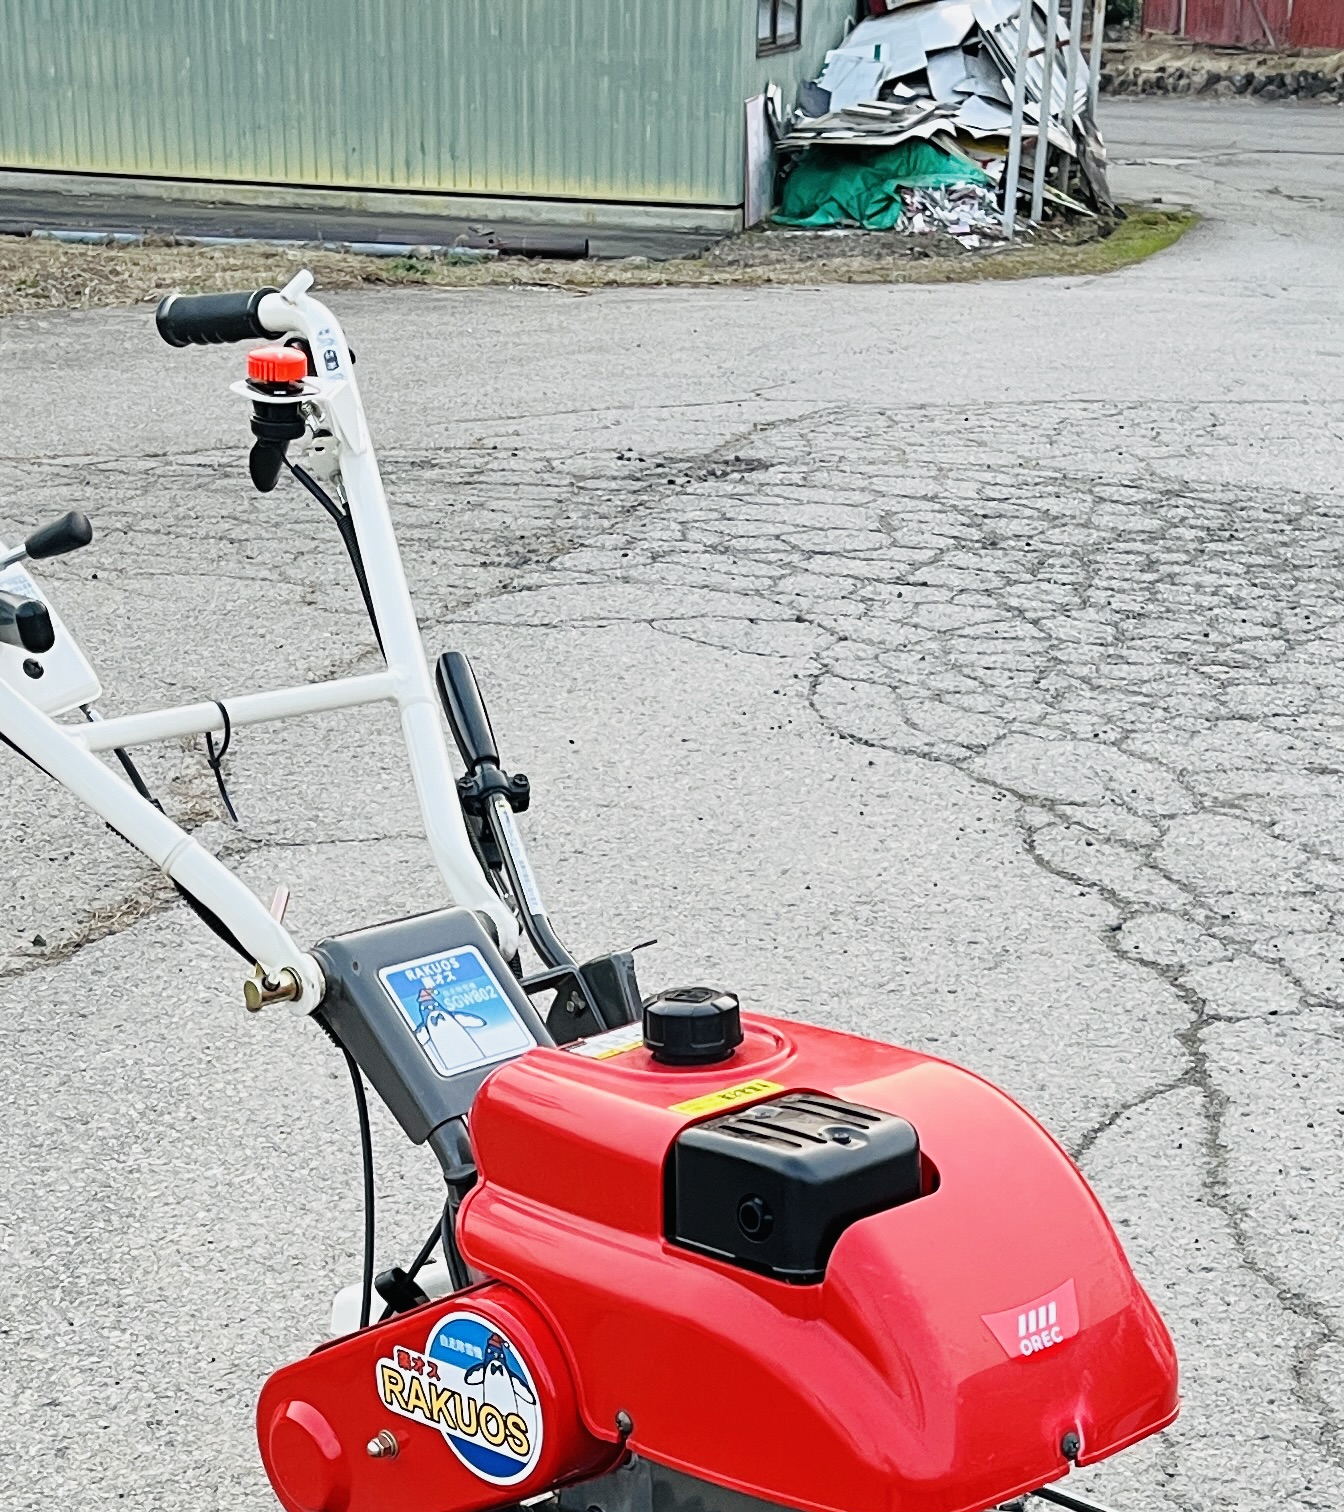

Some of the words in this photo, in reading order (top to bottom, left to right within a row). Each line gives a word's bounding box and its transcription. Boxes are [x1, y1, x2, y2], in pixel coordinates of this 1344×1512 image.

[404, 958, 460, 981] RAKUOS
[443, 985, 498, 1011] SGW802
[1019, 1326, 1064, 1356] OREC
[381, 1364, 531, 1456] RAKUOS
